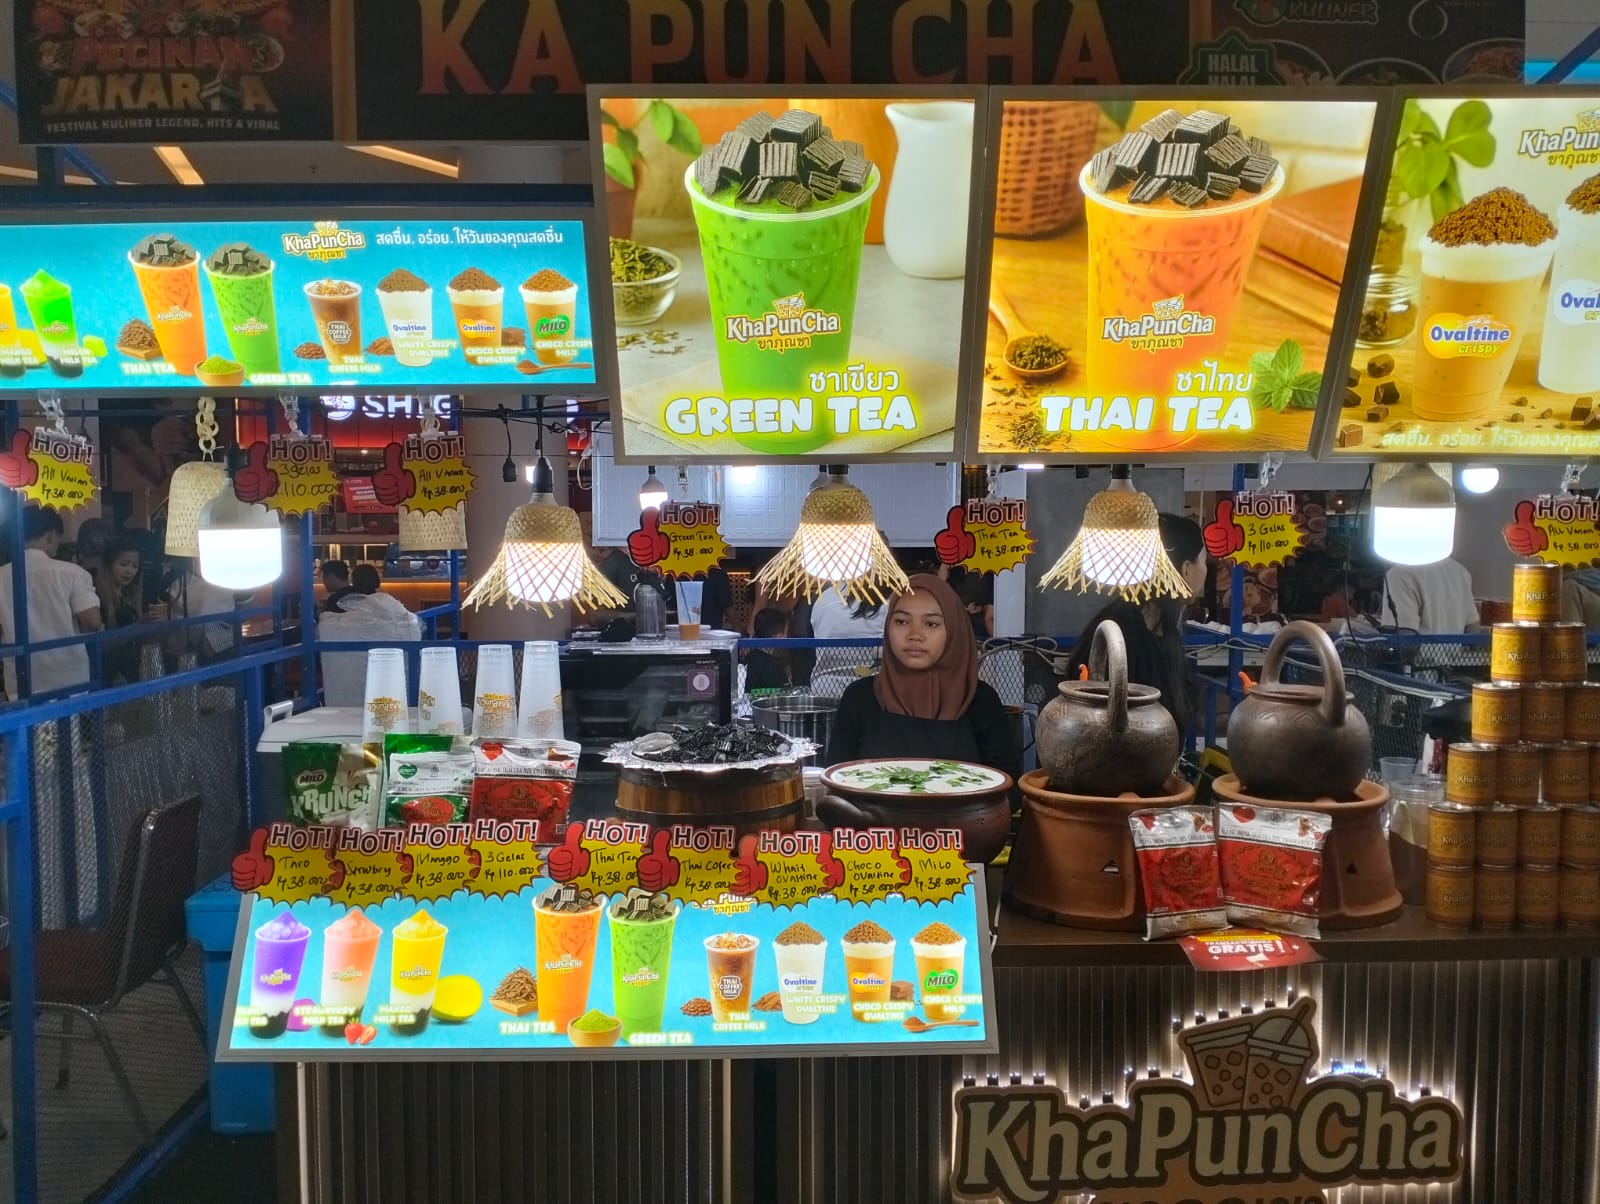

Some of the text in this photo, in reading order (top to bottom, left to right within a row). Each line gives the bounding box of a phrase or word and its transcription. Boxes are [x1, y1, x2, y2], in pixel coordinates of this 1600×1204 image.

[416, 0, 1123, 95] KA PUN CHA
[1208, 54, 1257, 73] HALAL
[47, 120, 98, 133] FESTIVAL
[102, 119, 152, 130] KULINER
[207, 118, 232, 130] HITS
[235, 118, 243, 130] &
[247, 119, 280, 131] VIRAL
[1519, 127, 1600, 157] KhaPun
[283, 232, 364, 253] KhaPunCha
[539, 321, 567, 333] MILO
[726, 311, 840, 341] KhaPunCha
[1103, 313, 1214, 341] KhaPunCha
[1431, 326, 1510, 342] Ovaltine
[1458, 343, 1500, 355] crispy
[121, 363, 176, 374] THAI TEA
[250, 374, 311, 385] GREEN TEA
[809, 363, 898, 392] ชาเขียว
[1176, 360, 1253, 393] ชาไทย
[665, 396, 916, 436] GREEN TEA
[1041, 396, 1252, 432] THAI TEA
[32, 429, 94, 464] HOT!
[270, 438, 333, 464] HOT!
[405, 435, 466, 463] HOT!
[660, 503, 721, 528] HOT!
[967, 500, 1027, 527] HOT!
[1236, 493, 1296, 519] HOT!
[1536, 498, 1599, 524] HOT!
[1248, 523, 1286, 536] 3 Gelas
[299, 773, 325, 784] MILO
[270, 823, 332, 851] HOT!
[339, 828, 404, 855] HOT!
[408, 823, 472, 849] HOT!
[475, 819, 539, 844] HOT!
[585, 819, 649, 845] HOT!
[672, 825, 736, 852] HOT!
[834, 828, 894, 853] HOT!
[901, 828, 961, 853] HOT!
[589, 847, 615, 865] Thai
[760, 832, 820, 856] HOT!
[485, 851, 494, 863] 3
[784, 978, 818, 986] Ovaltine
[852, 977, 886, 986] Ovaltine
[928, 975, 956, 987] MILO
[786, 995, 846, 1004] WHITE CRISPY
[796, 1005, 837, 1013] OVALTINE
[943, 1004, 966, 1013] MILO
[398, 1014, 416, 1024] TEA
[500, 1022, 556, 1034] THAI TEA
[713, 1021, 767, 1032] COFFEE MILK
[729, 1012, 750, 1022] THAI
[629, 1033, 693, 1045] GREEN TEA
[963, 1087, 1453, 1202] KhaPunCha
